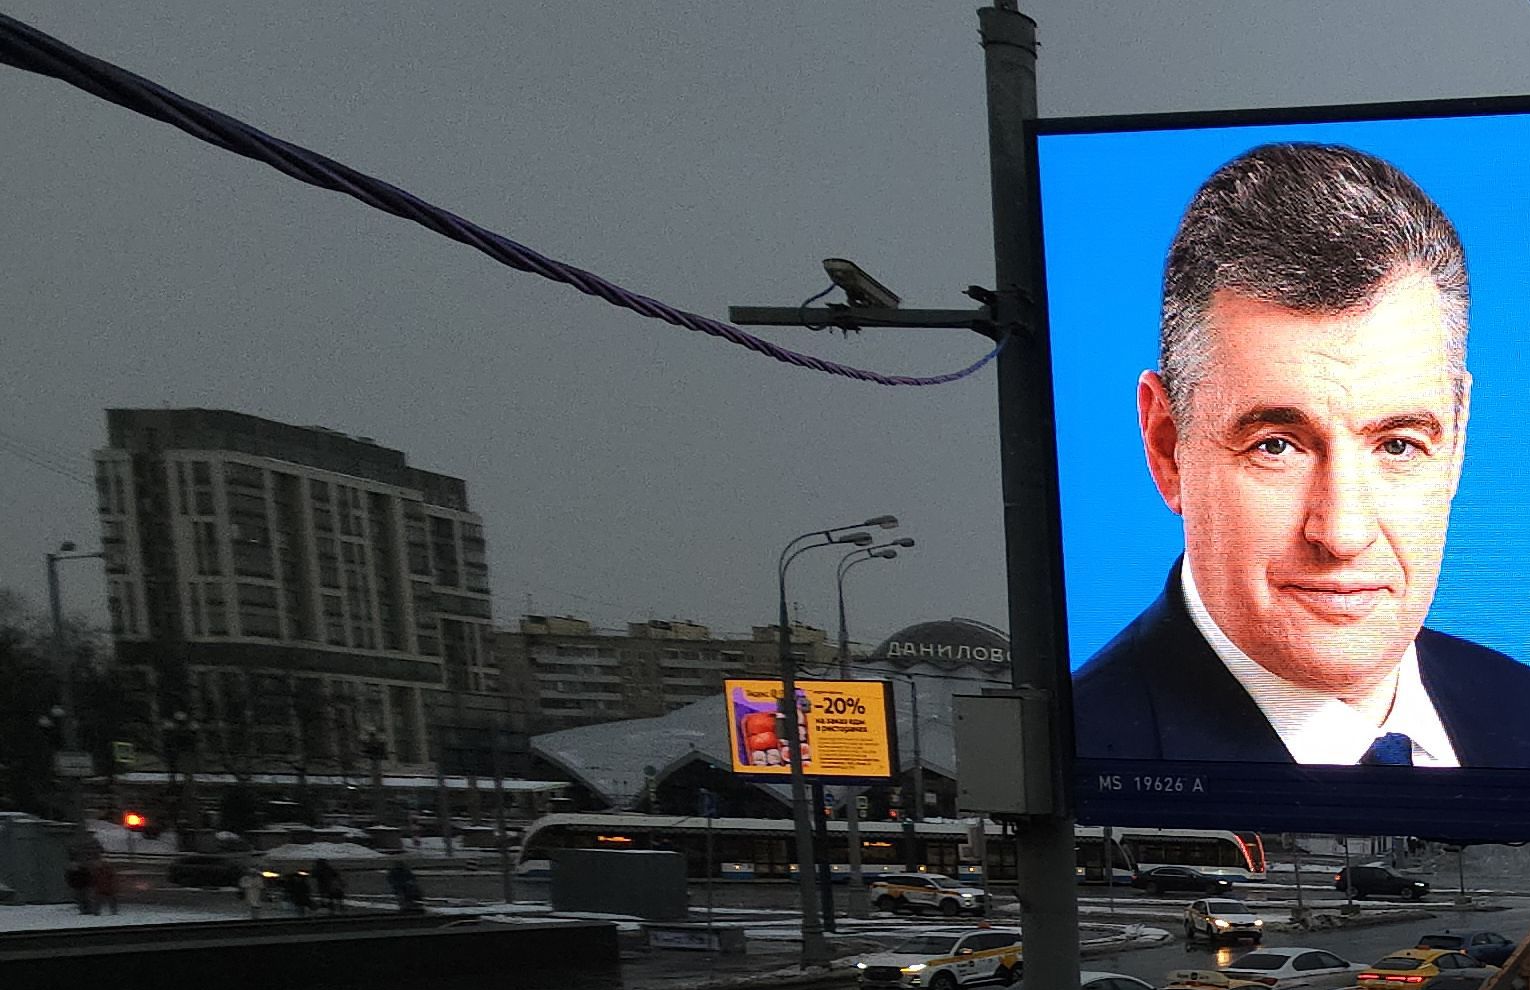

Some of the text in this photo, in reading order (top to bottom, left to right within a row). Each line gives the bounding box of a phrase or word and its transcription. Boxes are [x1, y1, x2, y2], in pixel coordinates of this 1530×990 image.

[814, 697, 865, 714] -20%
[1098, 776, 1205, 792] MS 19626 A
